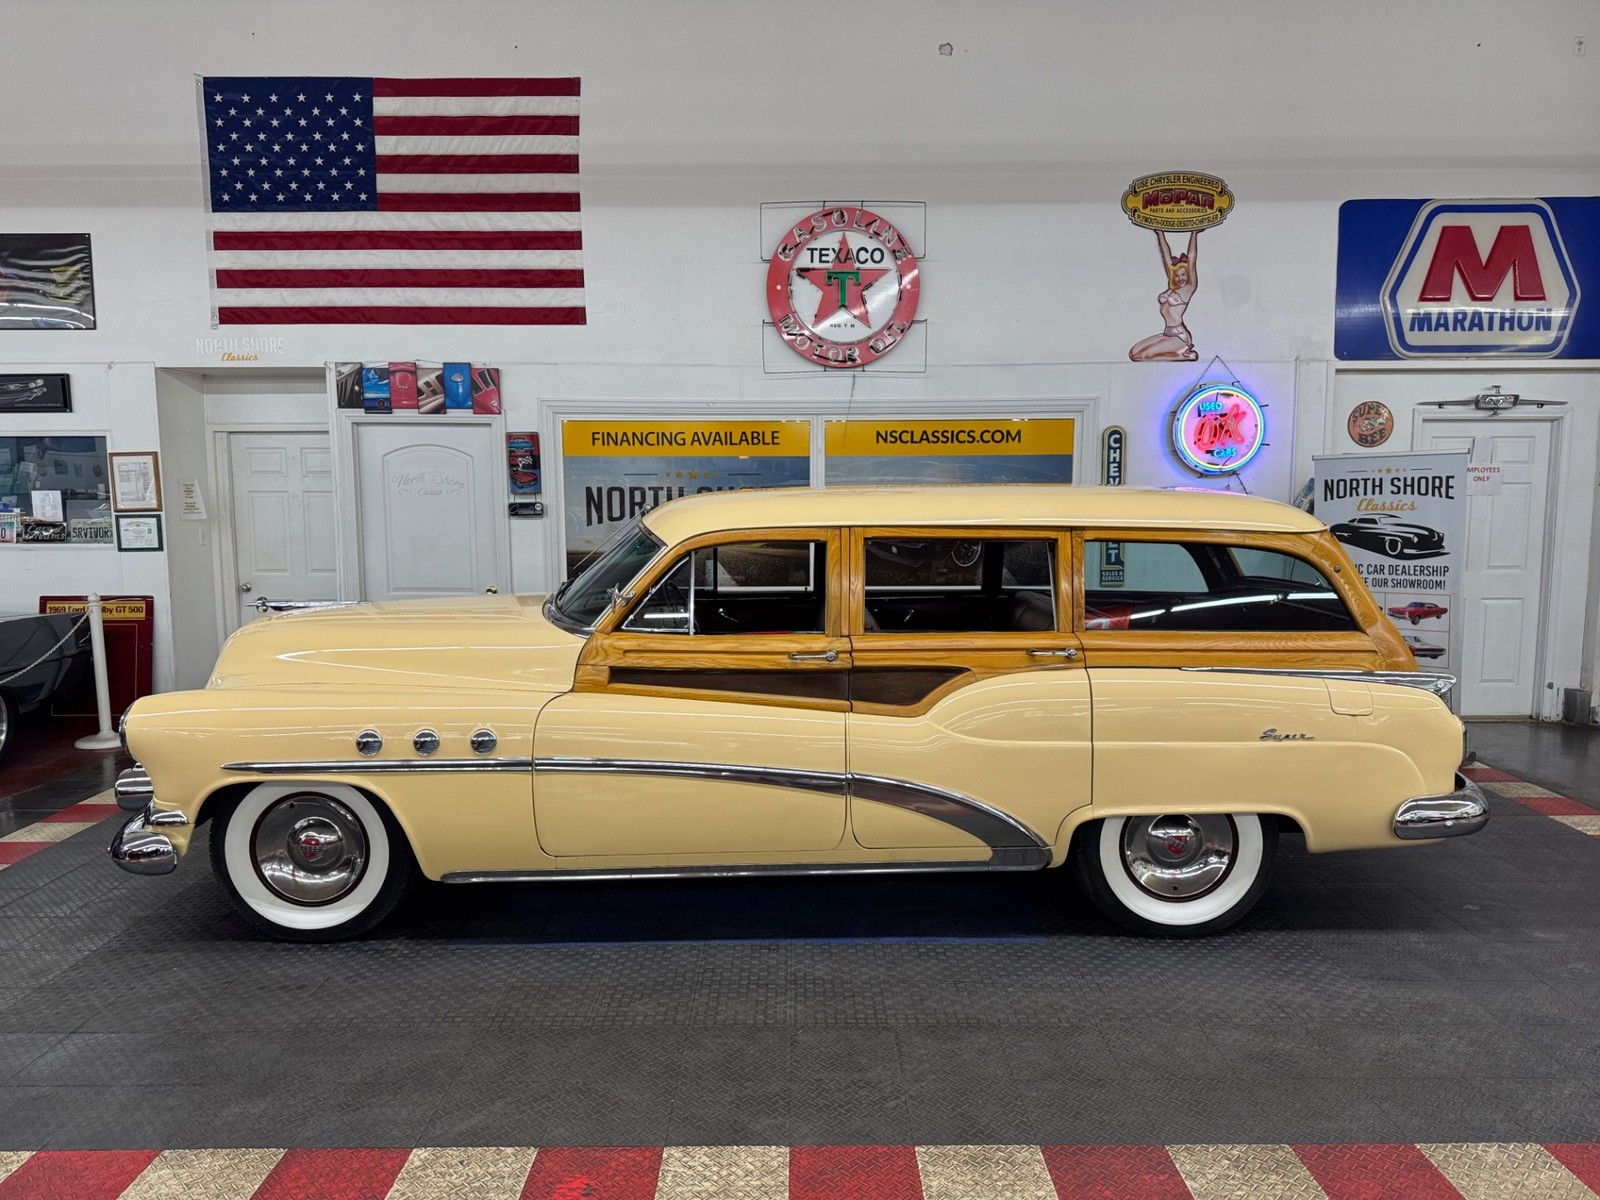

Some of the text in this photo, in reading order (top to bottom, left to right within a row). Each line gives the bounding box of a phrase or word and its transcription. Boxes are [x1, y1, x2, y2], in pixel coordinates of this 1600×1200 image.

[1136, 175, 1220, 189] USE CHRYSLER ENGINEERED
[1142, 188, 1215, 211] MOPAR
[778, 208, 912, 264] GASOLINE
[806, 246, 885, 265] TEXACO
[1417, 225, 1547, 302] M
[826, 270, 861, 308] T
[1408, 308, 1553, 332] MARATHON
[195, 337, 285, 354] NORTH SHORE
[779, 314, 861, 364] MOTOR
[221, 352, 260, 362] Classics
[1199, 401, 1223, 411] USED
[591, 430, 781, 447] FINANCING AVAILABLE
[875, 429, 1022, 444] NSCLASSICS.COM
[1358, 428, 1387, 445] BEE
[1213, 448, 1237, 458] CARS
[1323, 475, 1455, 502] NORTH SHORE
[1356, 498, 1418, 513] Classics
[1366, 564, 1386, 575] CAR
[1388, 564, 1450, 577] DEALERSHIP
[1371, 577, 1389, 588] OUR
[1390, 578, 1446, 590] SHOWROOM!
[115, 606, 127, 614] GT
